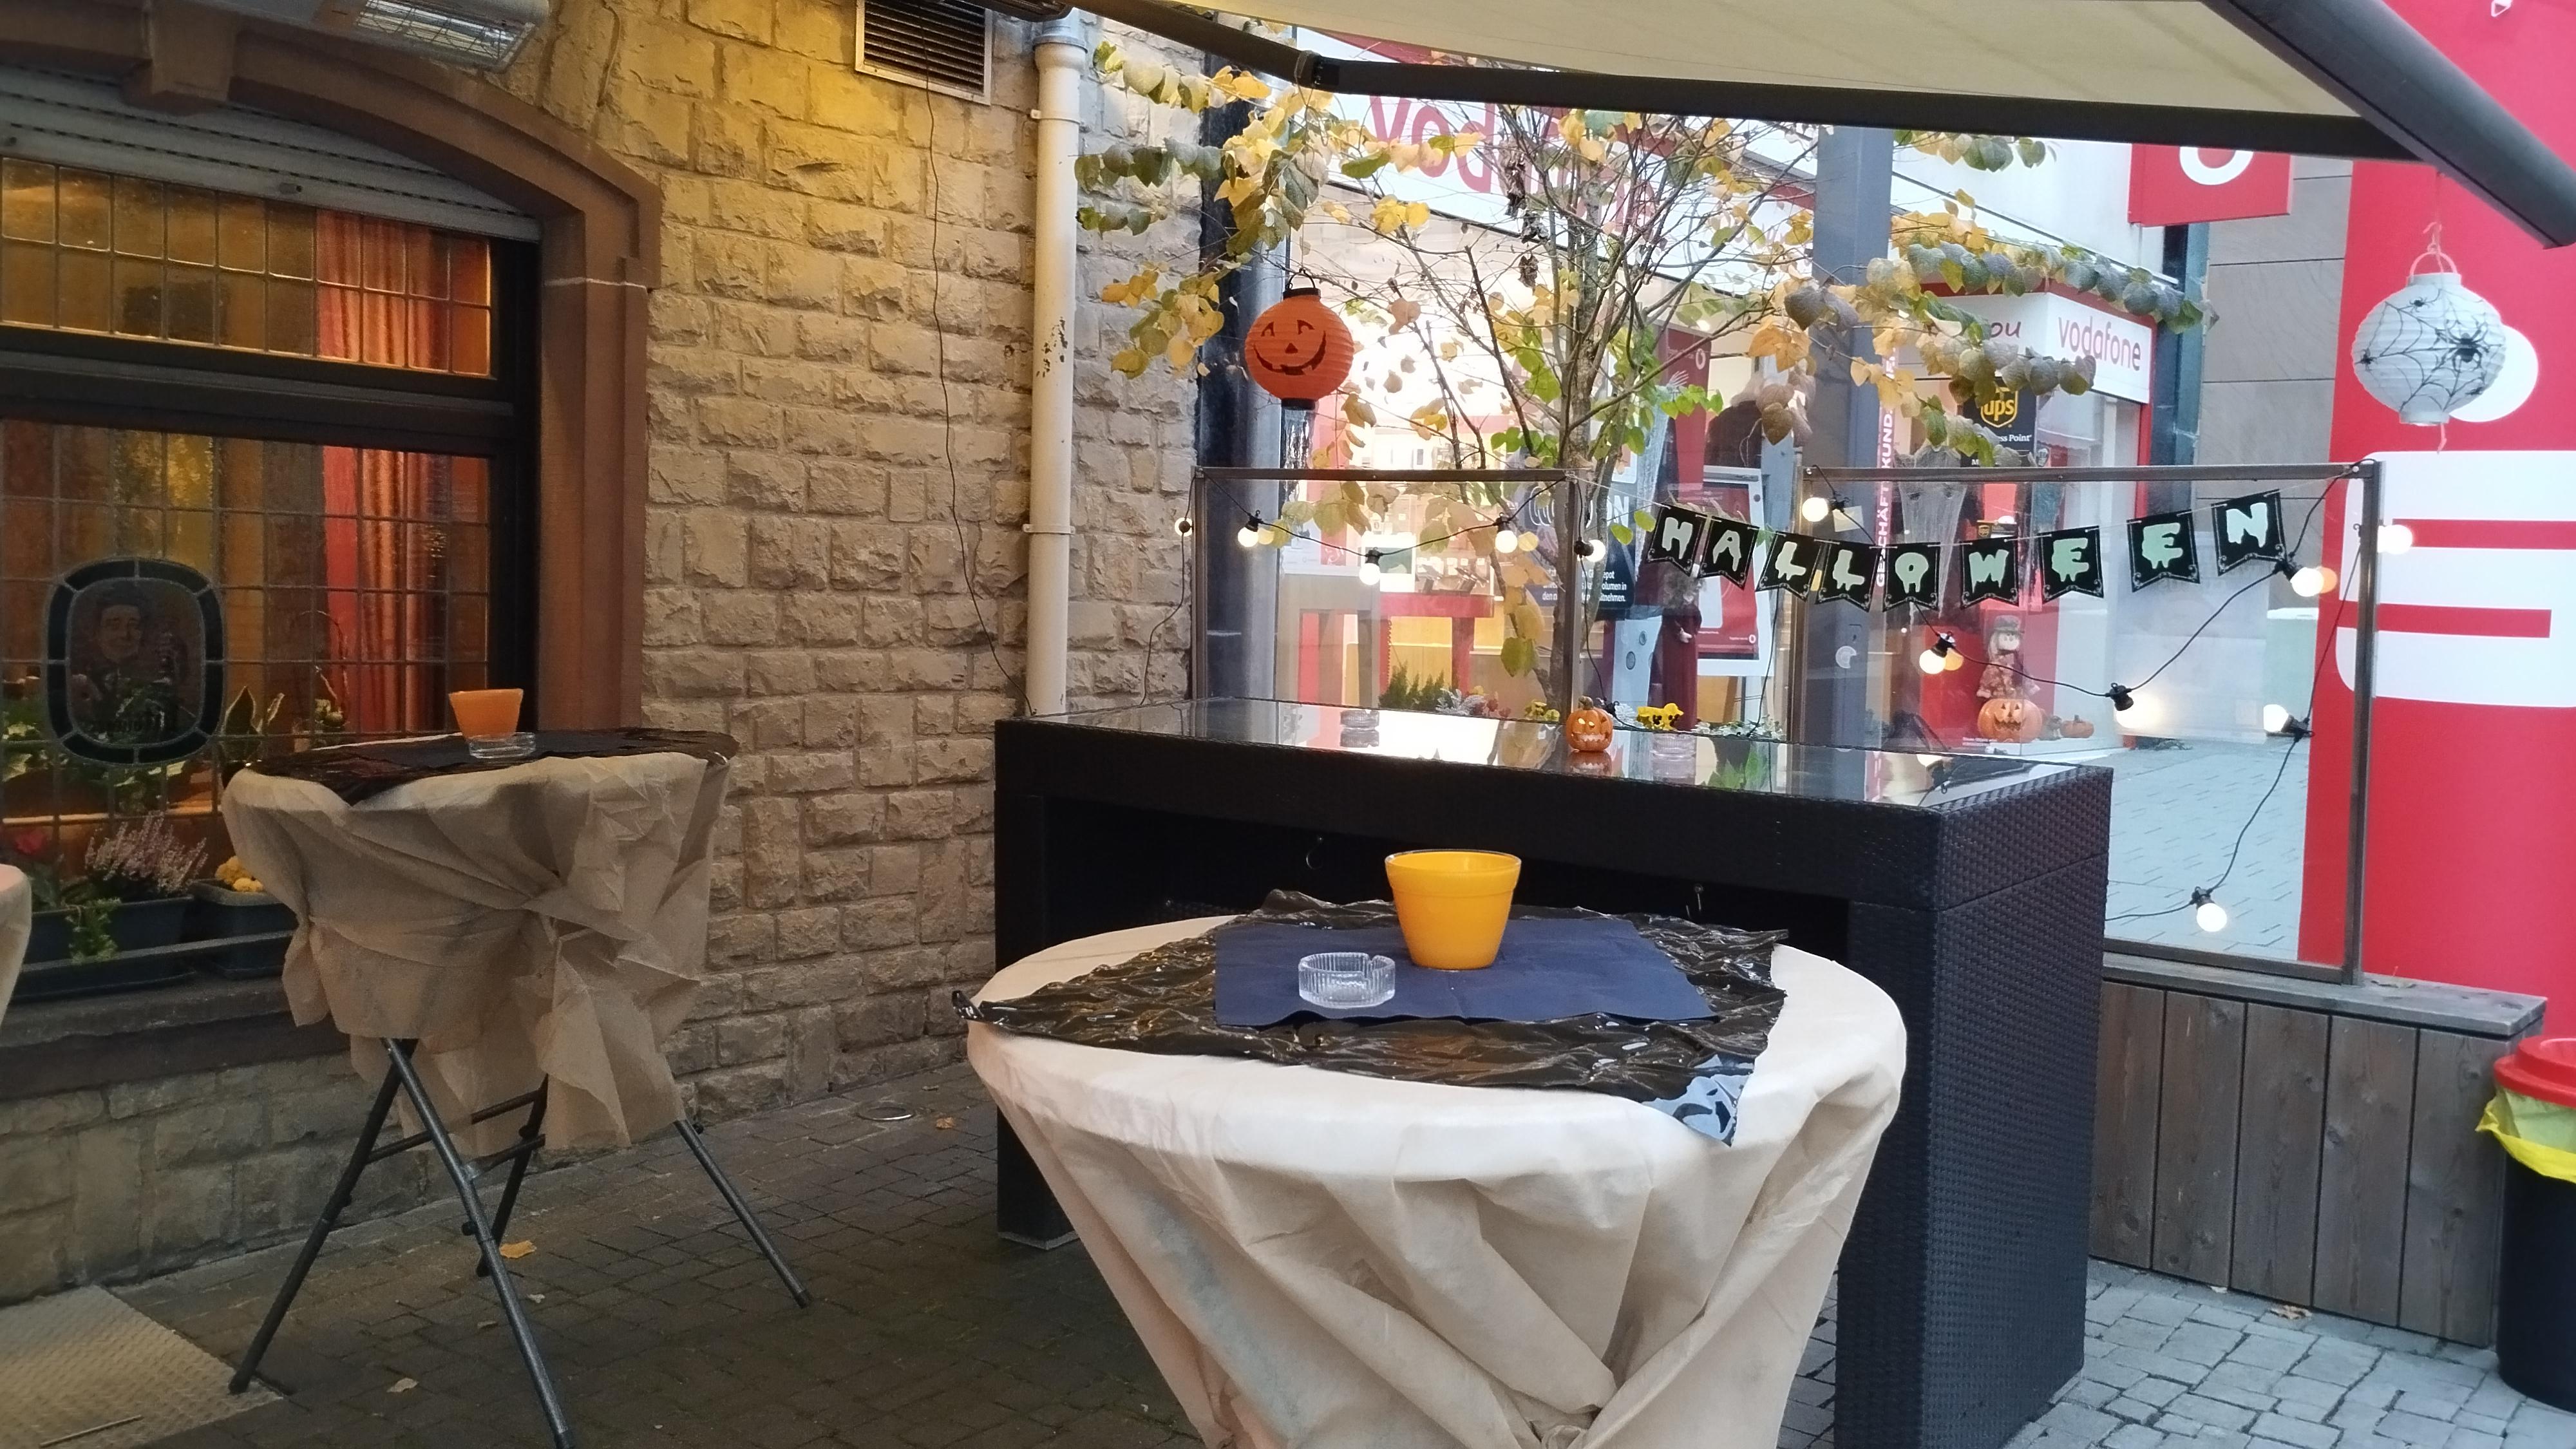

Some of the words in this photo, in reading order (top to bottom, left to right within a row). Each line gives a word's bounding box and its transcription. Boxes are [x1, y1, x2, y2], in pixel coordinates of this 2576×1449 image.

[2058, 316, 2141, 372] vodafone
[1662, 502, 2268, 594] HALLOWEEN
[1600, 592, 1626, 602] itnehmen.
